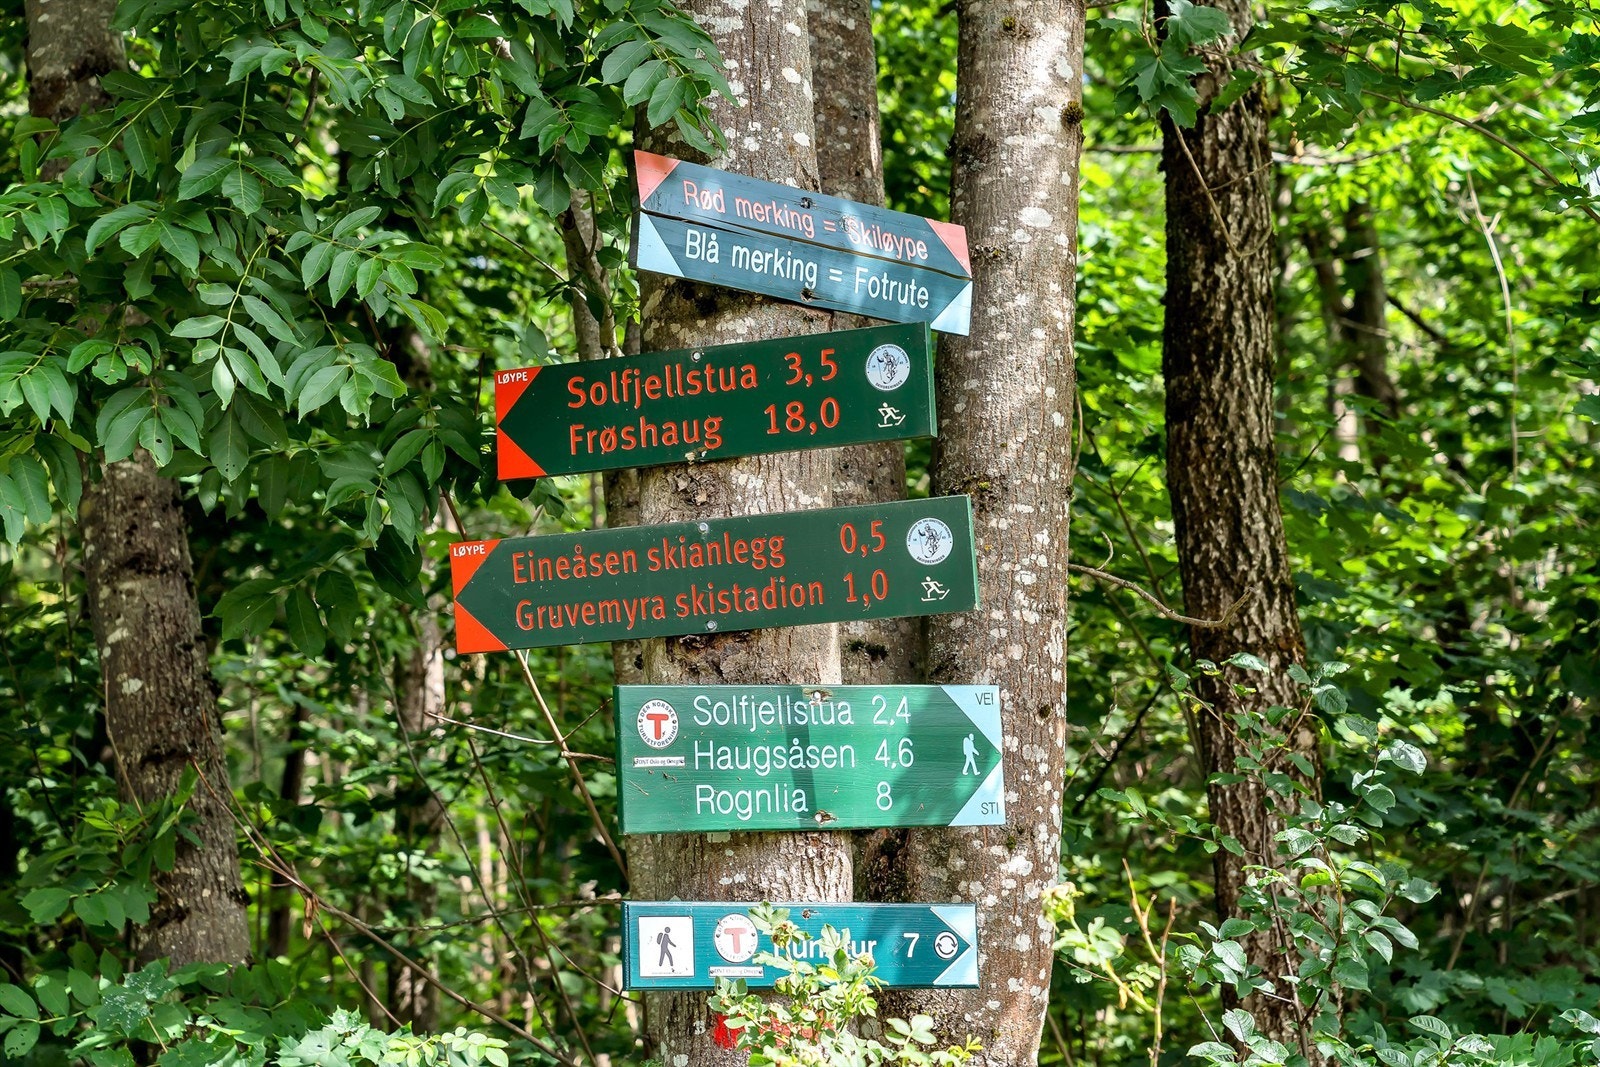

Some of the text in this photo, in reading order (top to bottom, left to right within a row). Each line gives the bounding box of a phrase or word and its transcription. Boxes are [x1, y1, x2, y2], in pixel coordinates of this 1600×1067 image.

[682, 180, 929, 260] Rød merking = Skiløype
[685, 229, 930, 309] Blå merking = Fotrute
[497, 371, 528, 385] LØYPE
[567, 362, 758, 410] Solfjellstua
[784, 348, 838, 387] 3,5
[569, 397, 840, 456] Frøshaug 18,0
[453, 544, 486, 557] LØYPE
[512, 544, 637, 584] Eineåsen
[648, 531, 786, 572] skianlegg
[840, 520, 886, 559] 0,5
[515, 569, 889, 631] Gruvemyra skistadion 1,0
[640, 702, 675, 718] DEN NORSKE
[693, 695, 911, 732] Solfjellstua 2,4
[975, 693, 994, 706] VEI
[638, 725, 677, 746] TURISTFORENING
[646, 713, 669, 740] T
[694, 738, 914, 776] Haugsåsen 4,6
[695, 781, 893, 820] Rognlia 8
[981, 802, 999, 815] STI
[903, 933, 920, 958] 7
